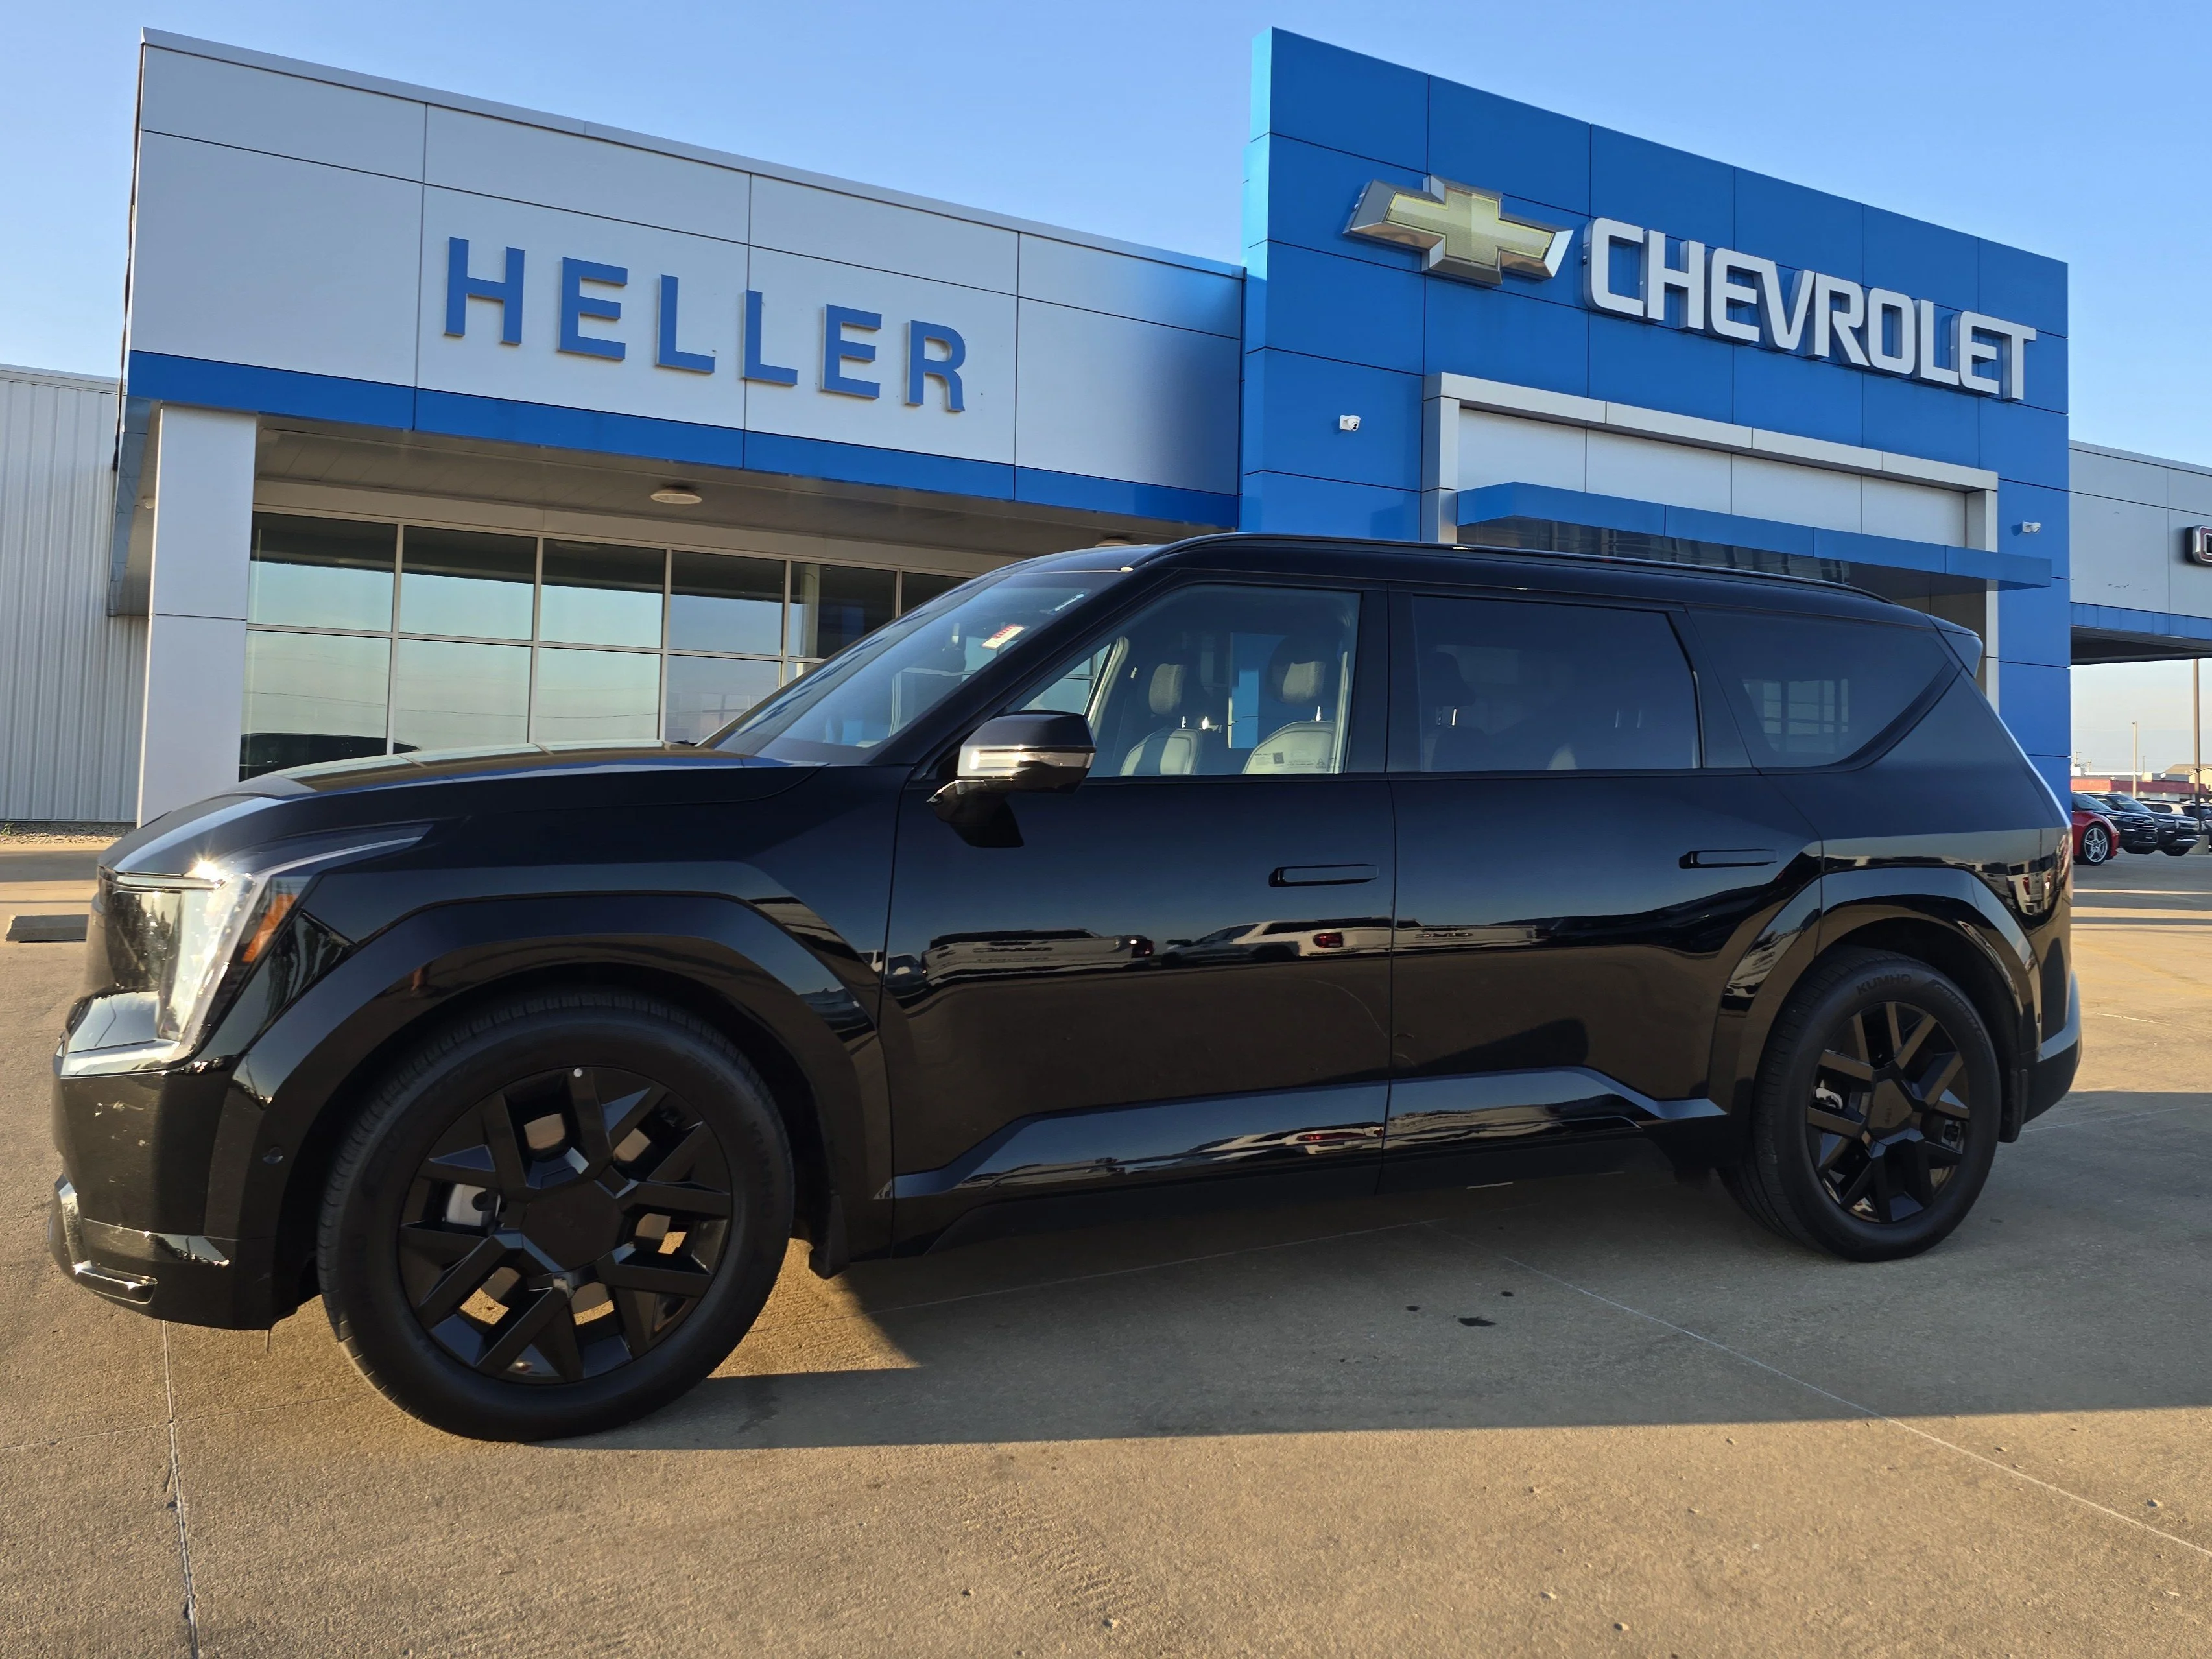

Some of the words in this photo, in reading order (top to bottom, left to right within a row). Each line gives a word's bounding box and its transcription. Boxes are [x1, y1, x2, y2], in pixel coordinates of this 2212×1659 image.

[444, 236, 966, 412] HELLER
[1584, 217, 2036, 401] CHEVROLET
[1856, 973, 1912, 996] KUMHO
